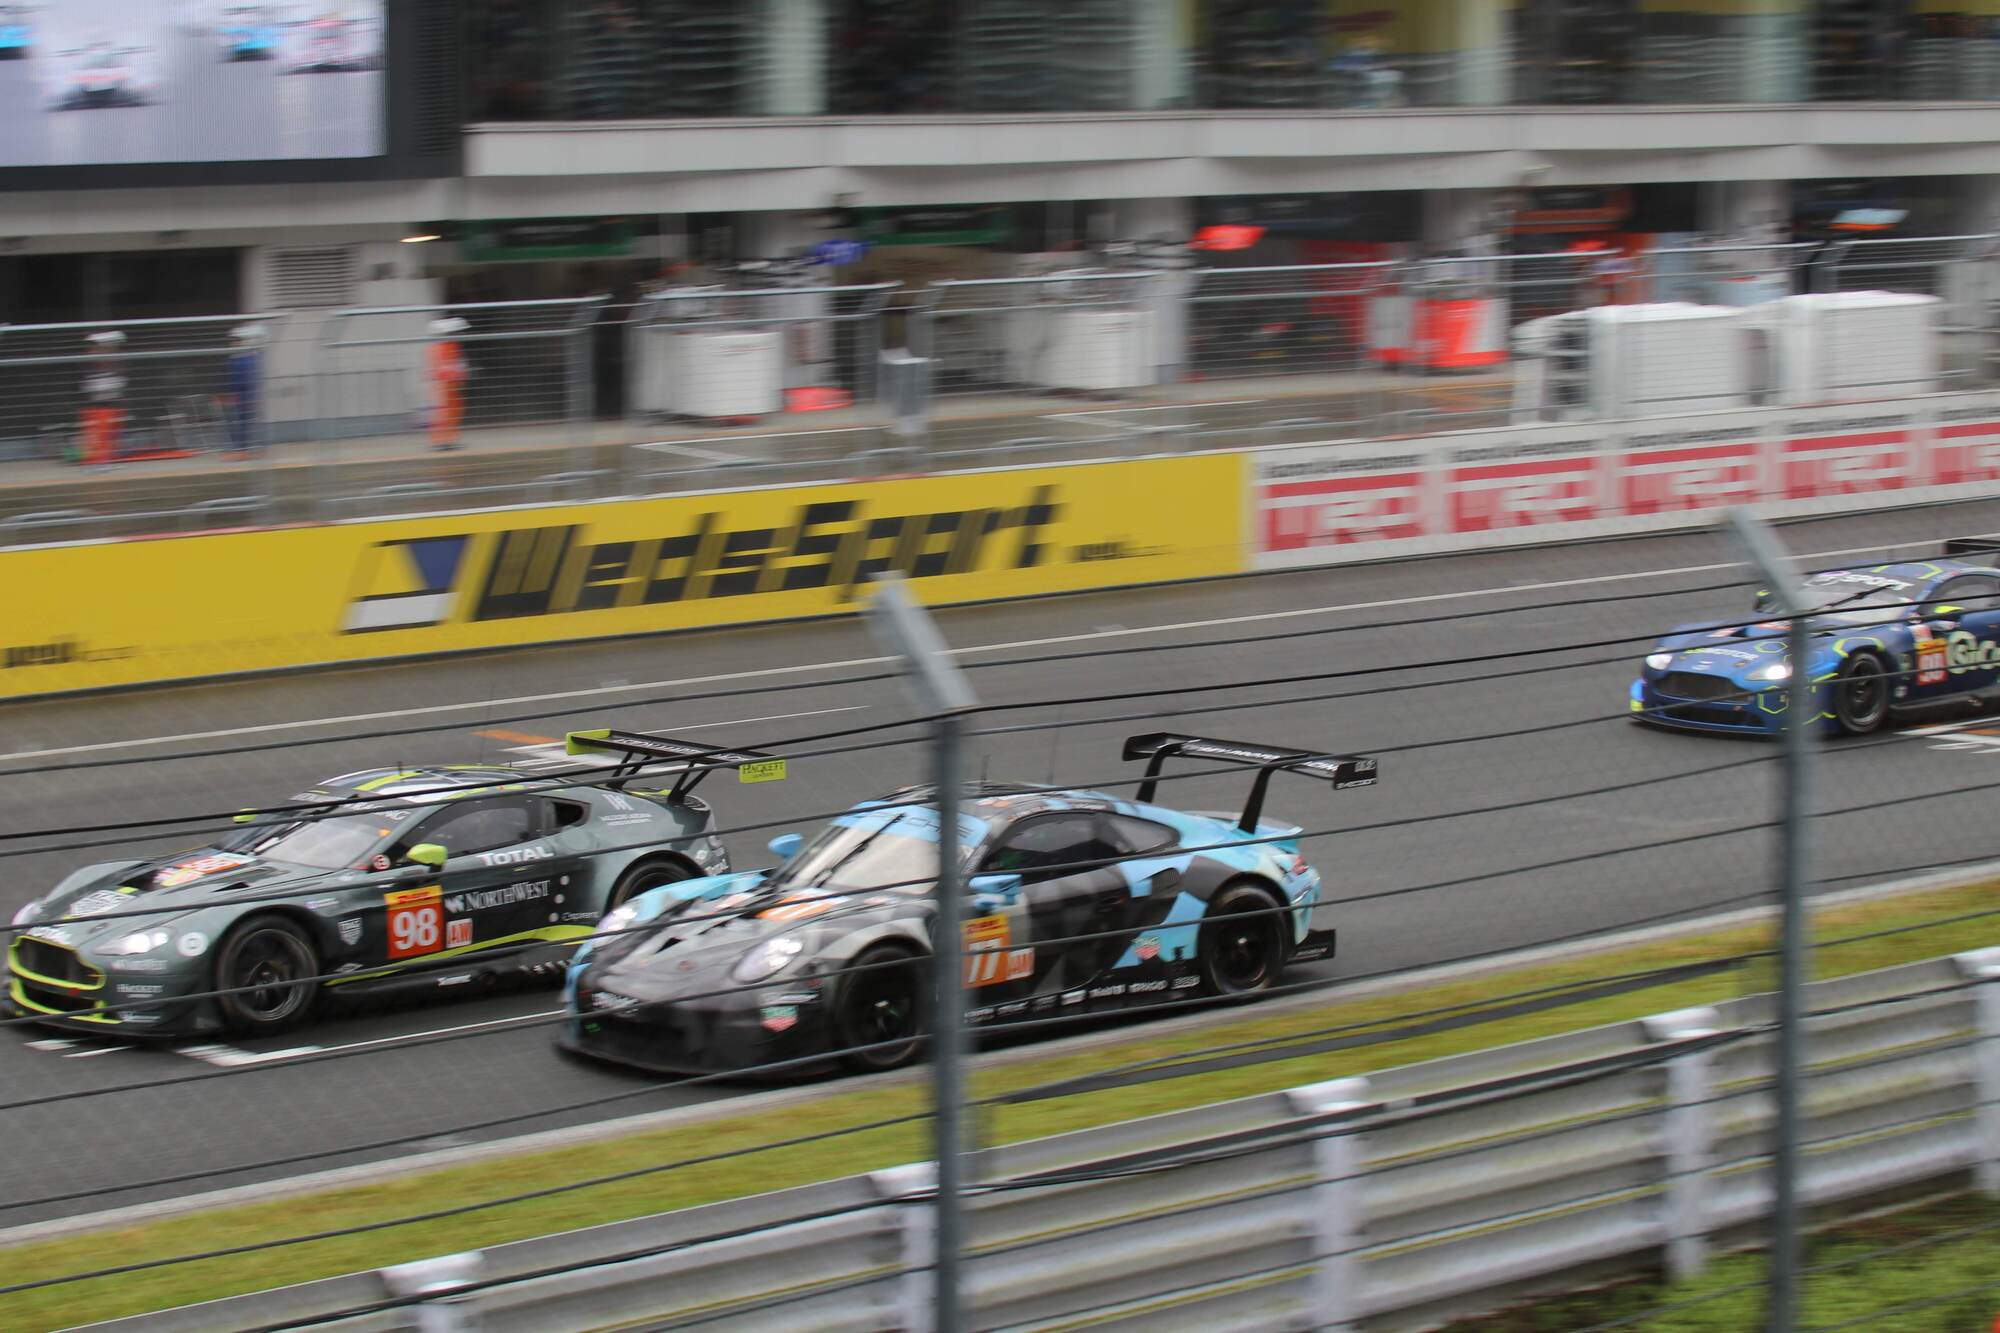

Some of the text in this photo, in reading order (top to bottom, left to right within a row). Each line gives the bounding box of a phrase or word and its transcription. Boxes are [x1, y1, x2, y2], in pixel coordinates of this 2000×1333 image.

[474, 485, 1062, 620] WedsSport
[475, 846, 554, 867] TOTAL
[393, 908, 439, 950] 98
[968, 938, 1003, 984] 77
